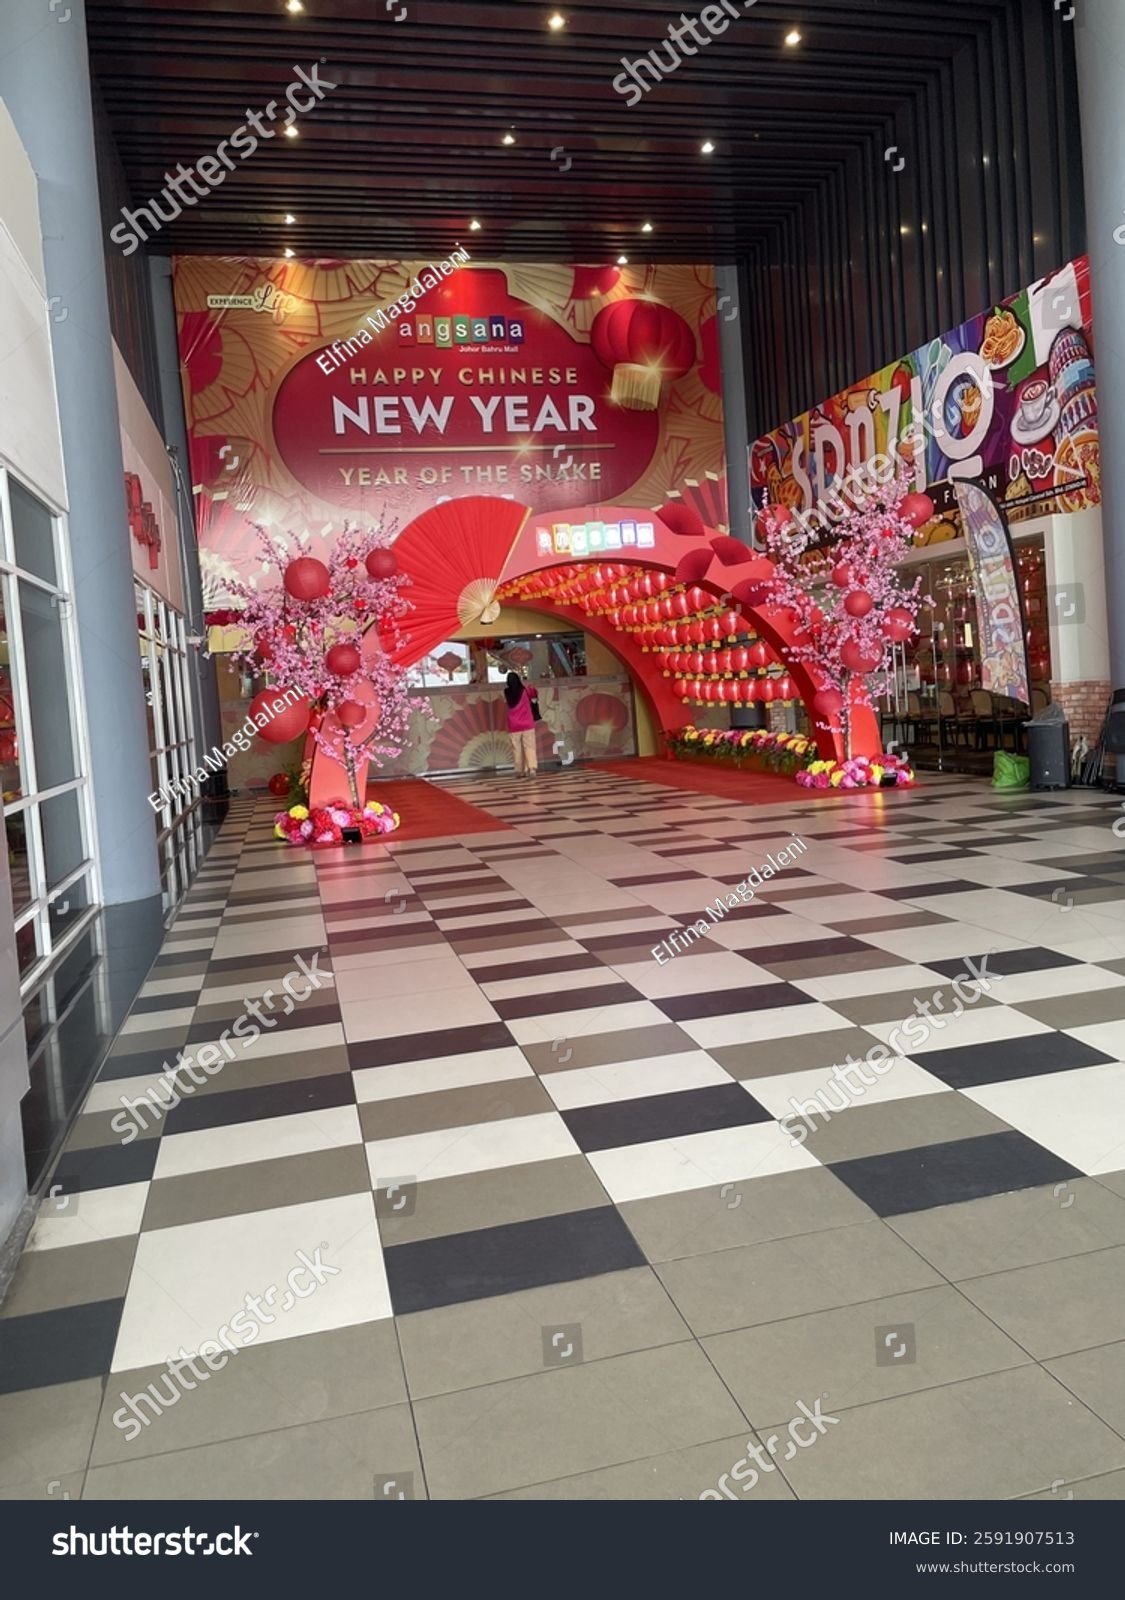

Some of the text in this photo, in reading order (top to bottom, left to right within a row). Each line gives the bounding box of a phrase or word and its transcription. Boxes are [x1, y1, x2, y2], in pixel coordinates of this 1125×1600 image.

[399, 320, 523, 342] angsana
[350, 366, 578, 385] HAPPY CHINESE
[332, 393, 599, 435] NEW YEAR
[339, 462, 602, 486] YEAR OF THE SNAKE
